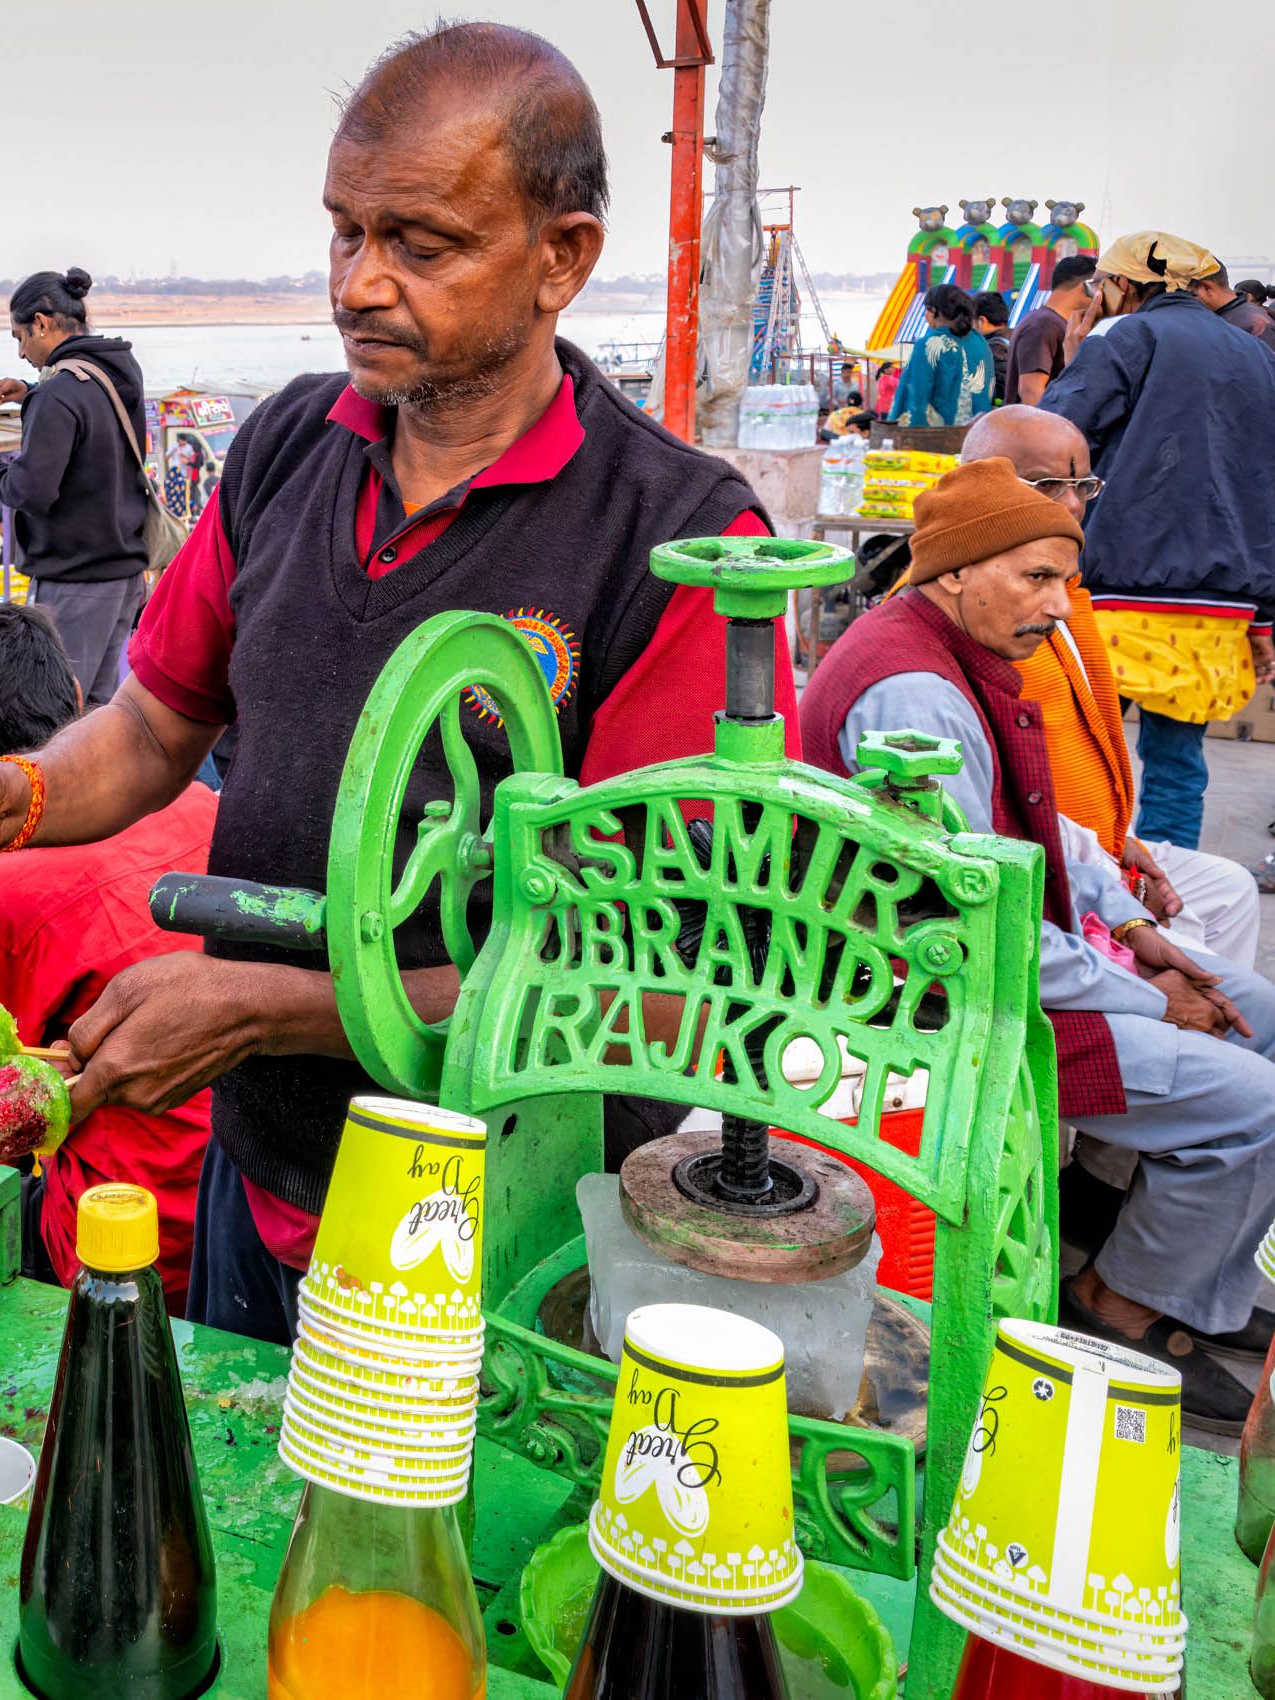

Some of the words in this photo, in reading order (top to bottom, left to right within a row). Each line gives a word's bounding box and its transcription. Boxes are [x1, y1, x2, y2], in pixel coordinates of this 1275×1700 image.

[572, 799, 922, 946] SAMIR
[582, 898, 893, 1024] BRAND
[538, 988, 930, 1142] RAJKOT
[407, 1144, 465, 1196] Day
[408, 1175, 482, 1242] Great
[627, 1368, 681, 1434] Day
[626, 1418, 722, 1488] Great
